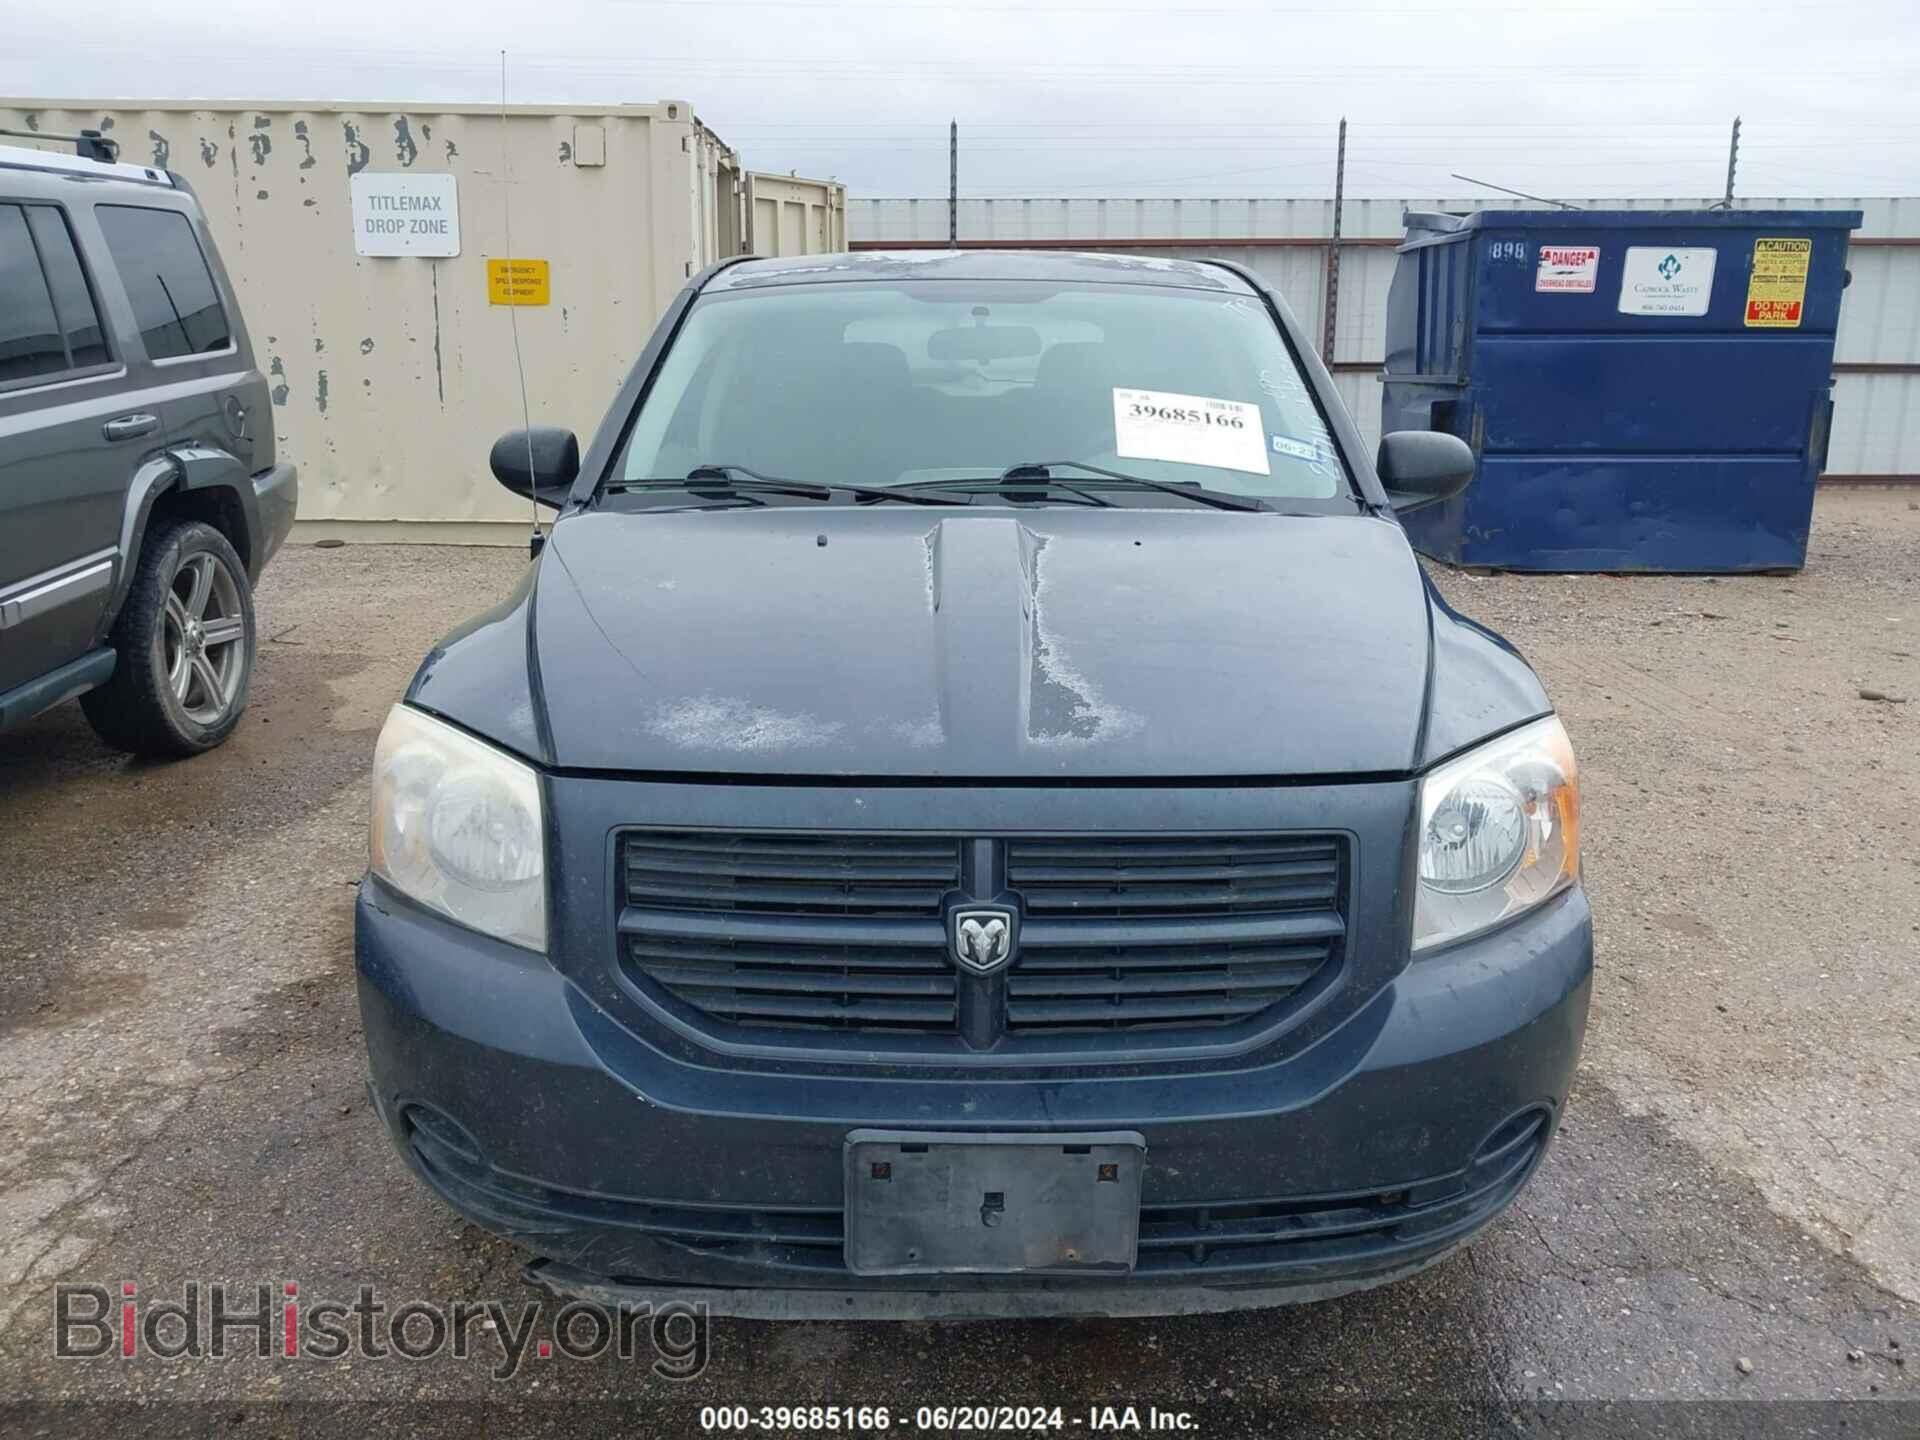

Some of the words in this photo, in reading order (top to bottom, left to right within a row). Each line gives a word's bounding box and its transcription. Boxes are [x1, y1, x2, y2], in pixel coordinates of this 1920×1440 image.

[368, 195, 441, 212] TITLEMAX
[365, 218, 405, 234] DROP
[410, 219, 448, 235] ZONE
[1766, 241, 1809, 251] CAUTION
[1551, 251, 1586, 266] DANGER
[1754, 302, 1770, 311] DO
[1773, 302, 1796, 311] NOT
[1758, 311, 1788, 320] PARK
[1128, 403, 1244, 429] 39685166
